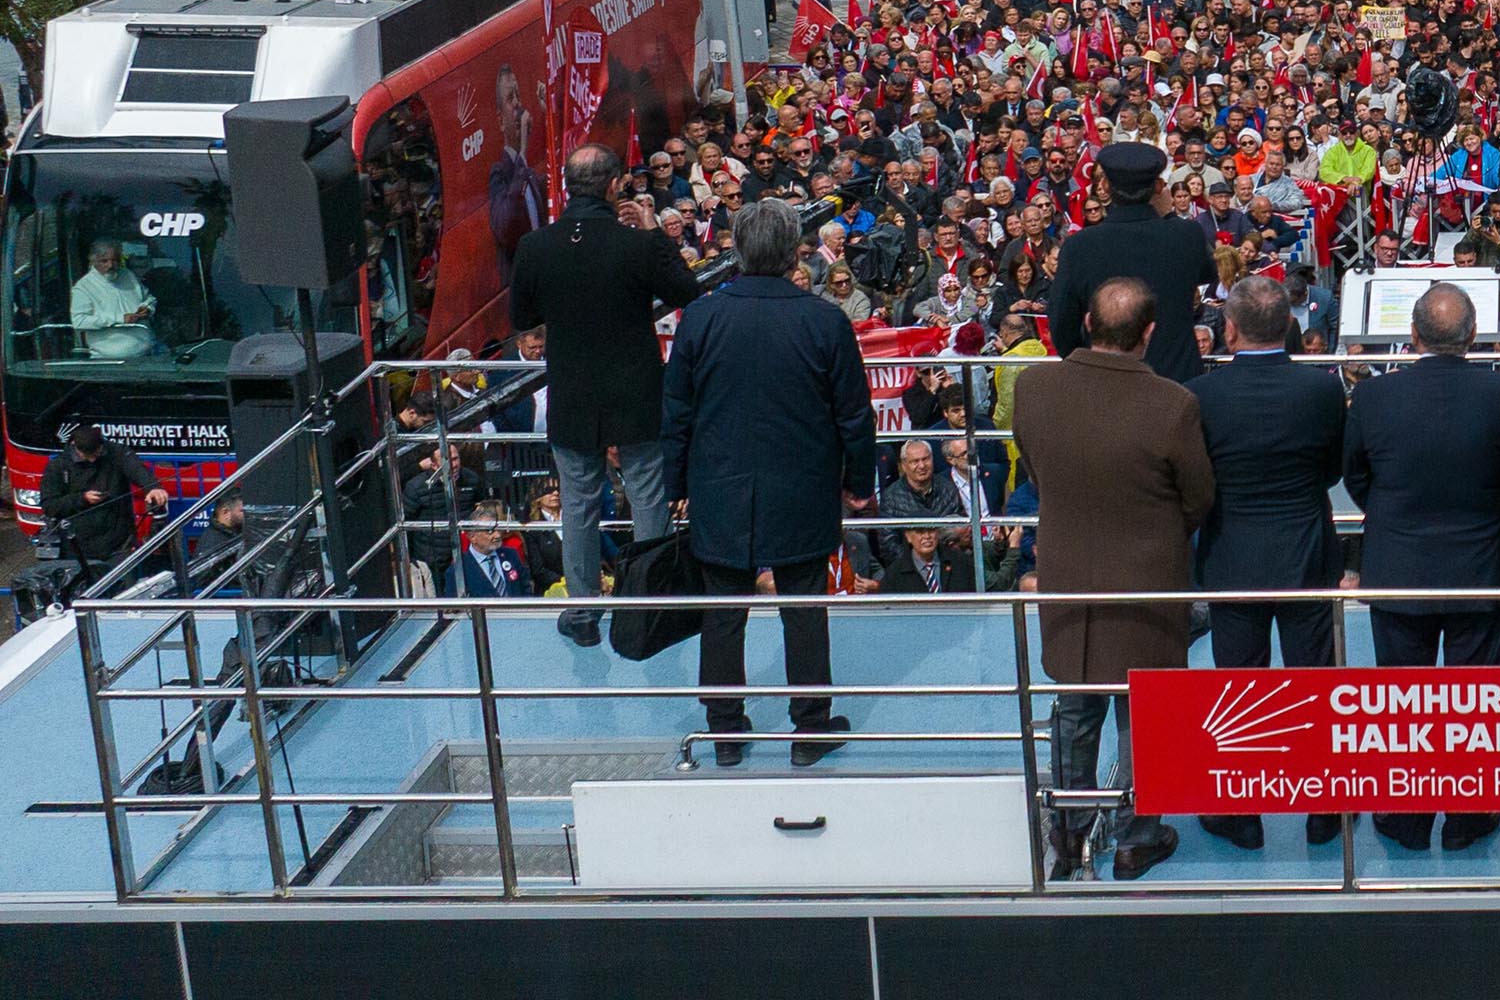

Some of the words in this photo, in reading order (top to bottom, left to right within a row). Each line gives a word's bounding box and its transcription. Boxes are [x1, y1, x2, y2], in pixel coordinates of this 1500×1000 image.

[577, 33, 600, 59] İRADE
[802, 23, 819, 45] CHP
[462, 129, 484, 162] CHP
[140, 212, 205, 237] CHP
[181, 438, 231, 447] BİRİNCİ
[187, 425, 228, 438] HALK
[1331, 723, 1433, 753] HALK
[1208, 768, 1378, 805] Türkiye'nin
[1389, 767, 1484, 797] Birinci
